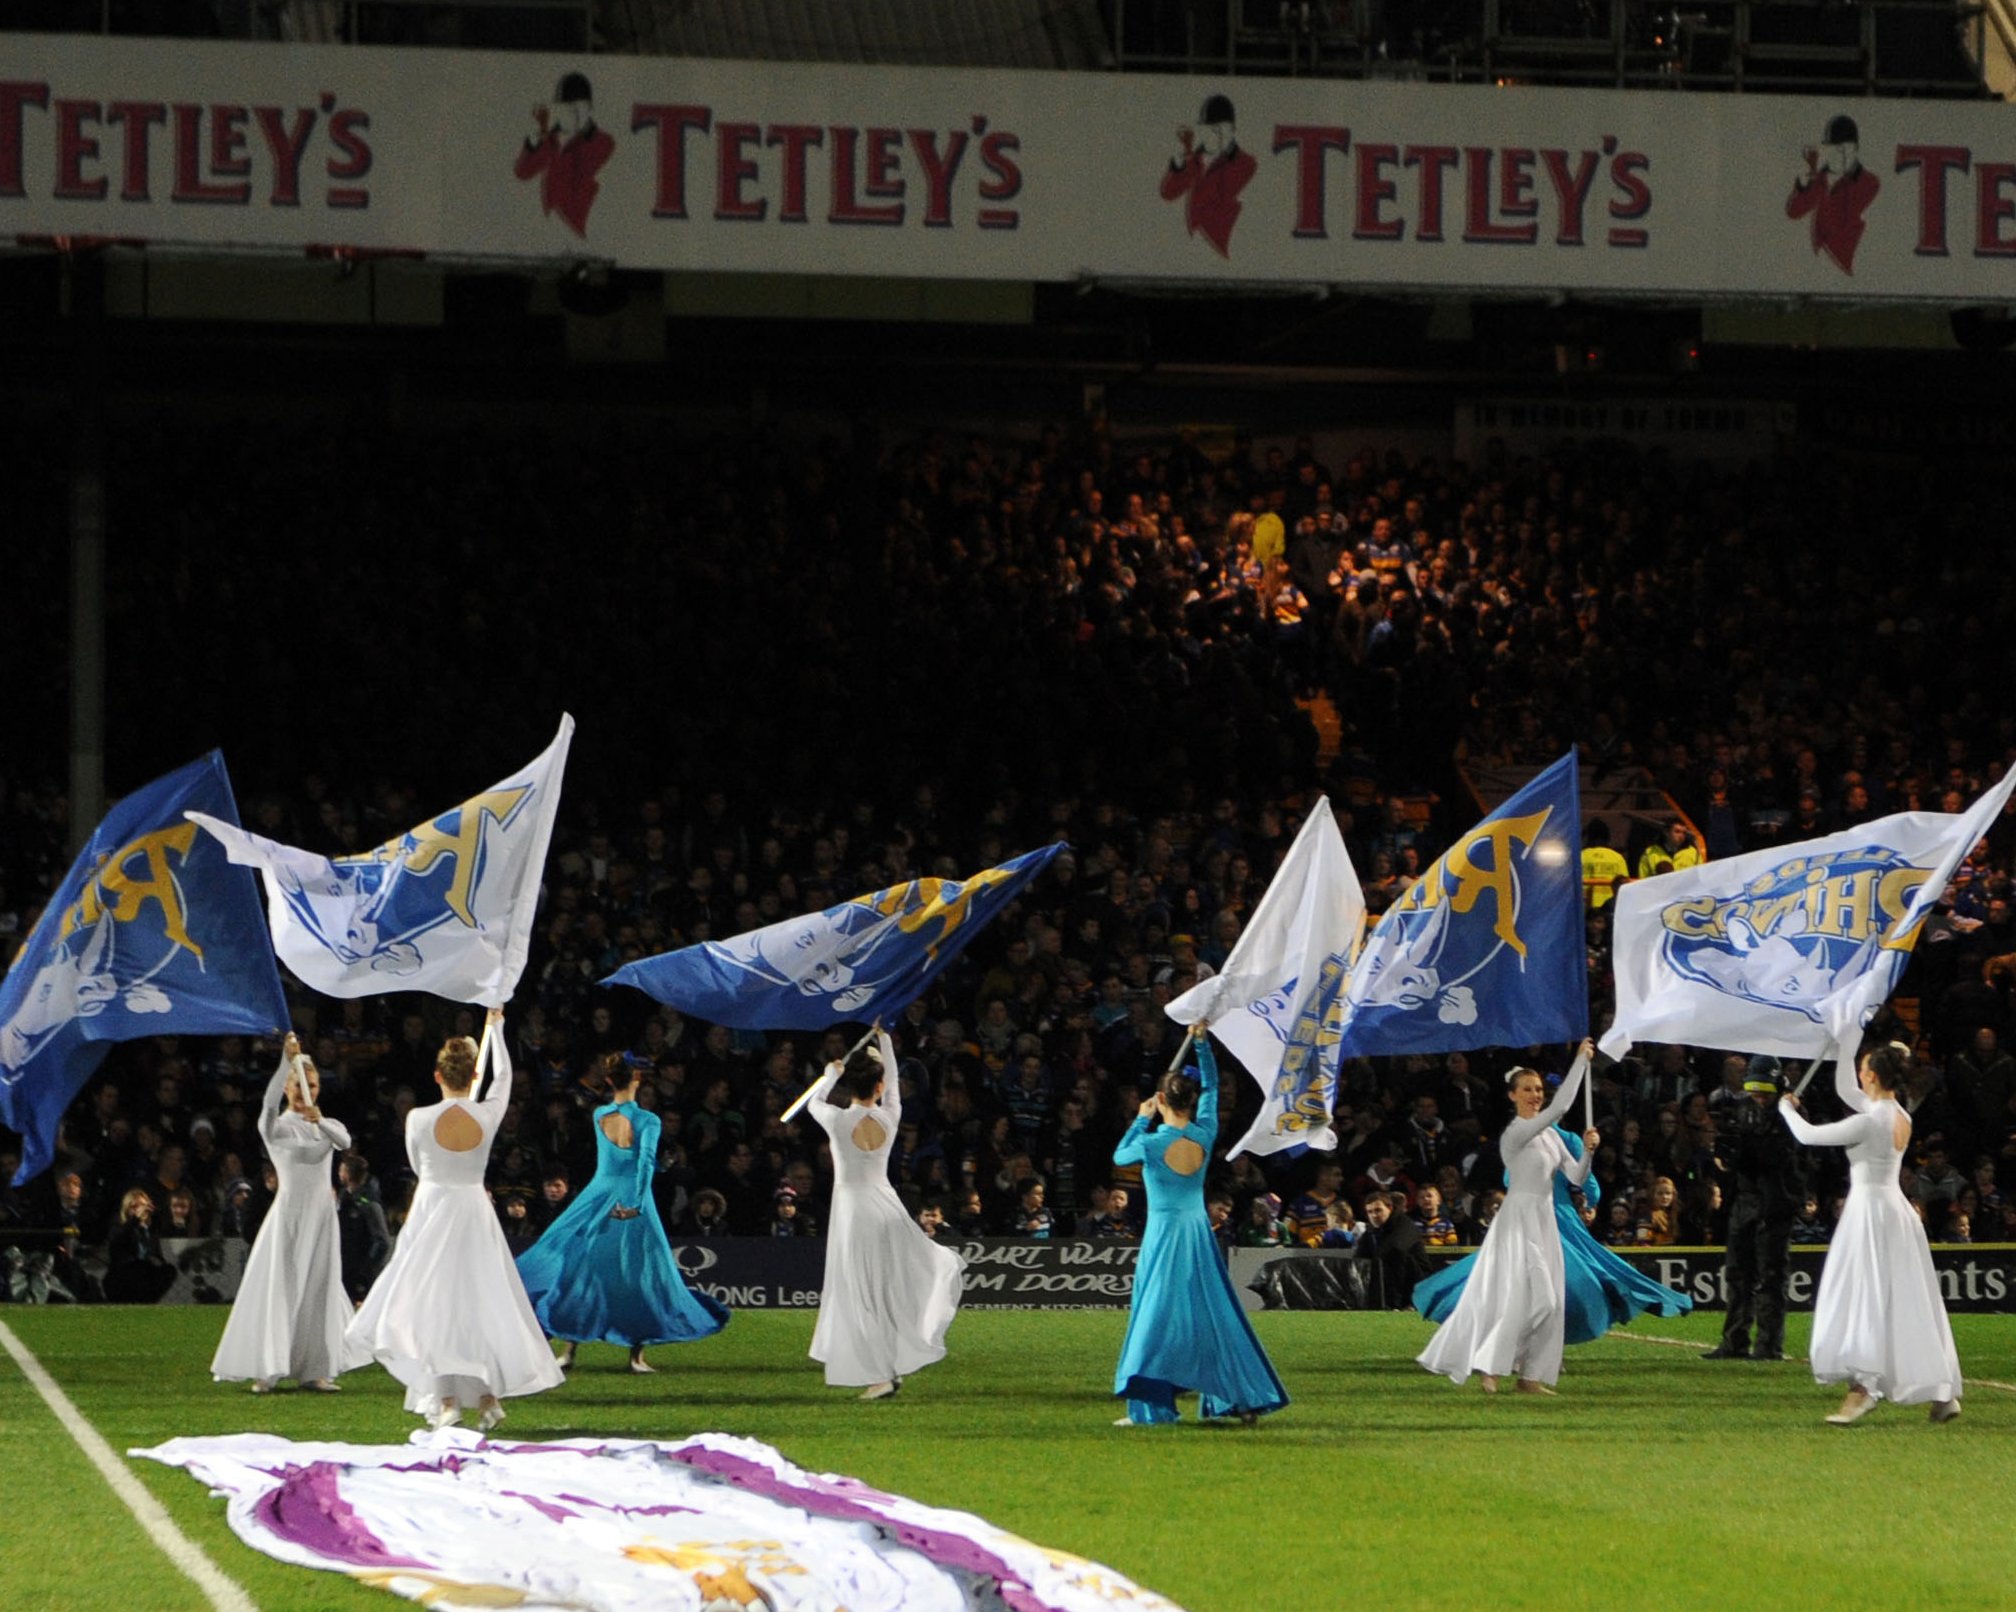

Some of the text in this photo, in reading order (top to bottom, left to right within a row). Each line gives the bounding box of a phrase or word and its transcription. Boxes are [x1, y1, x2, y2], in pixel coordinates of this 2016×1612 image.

[0, 82, 372, 209] TETLEY'S
[631, 103, 1023, 229] TETLEY'S
[1273, 125, 1652, 247] TETLEY'S
[778, 1286, 822, 1305] Lee
